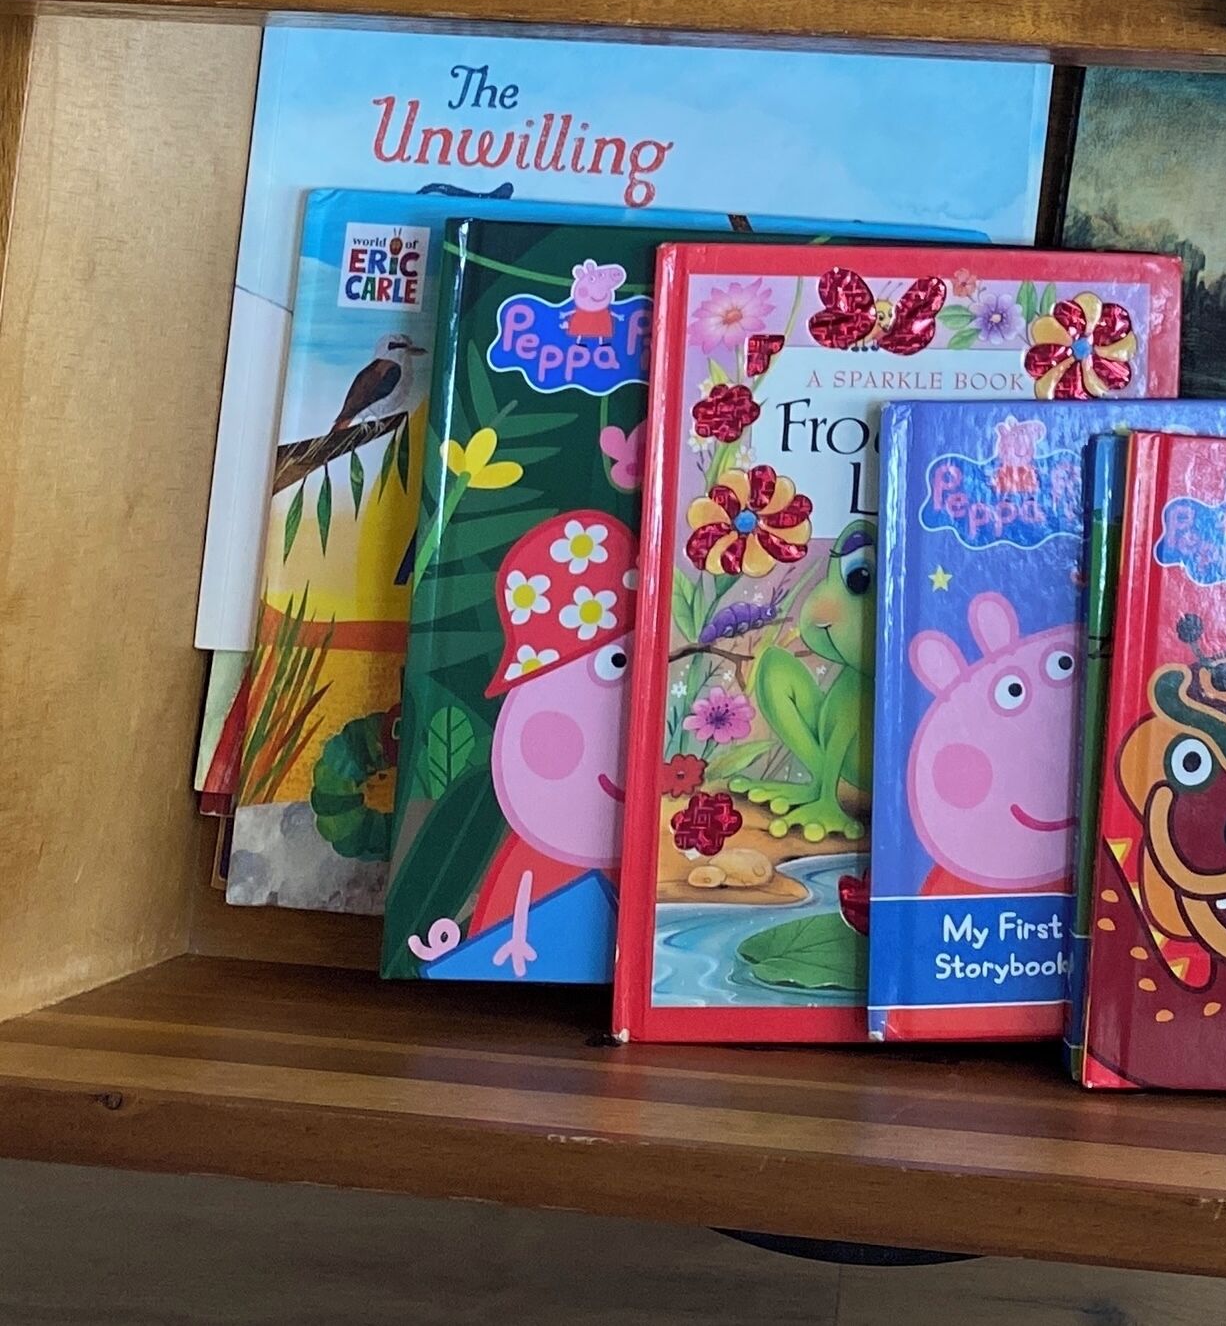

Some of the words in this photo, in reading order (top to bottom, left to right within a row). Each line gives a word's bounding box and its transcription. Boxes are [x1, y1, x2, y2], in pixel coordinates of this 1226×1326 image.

[448, 64, 520, 110] The
[372, 96, 674, 209] Unwilling
[353, 237, 387, 248] world
[405, 240, 419, 250] of
[345, 275, 418, 305] CARLE
[503, 304, 620, 382] Peppa
[806, 371, 823, 388] A
[832, 371, 942, 391] SPARKLE
[954, 373, 1025, 391] BOOK
[776, 398, 880, 456] Fro
[932, 462, 1047, 539] Peppa
[943, 913, 990, 949] My
[1000, 911, 1063, 941] First
